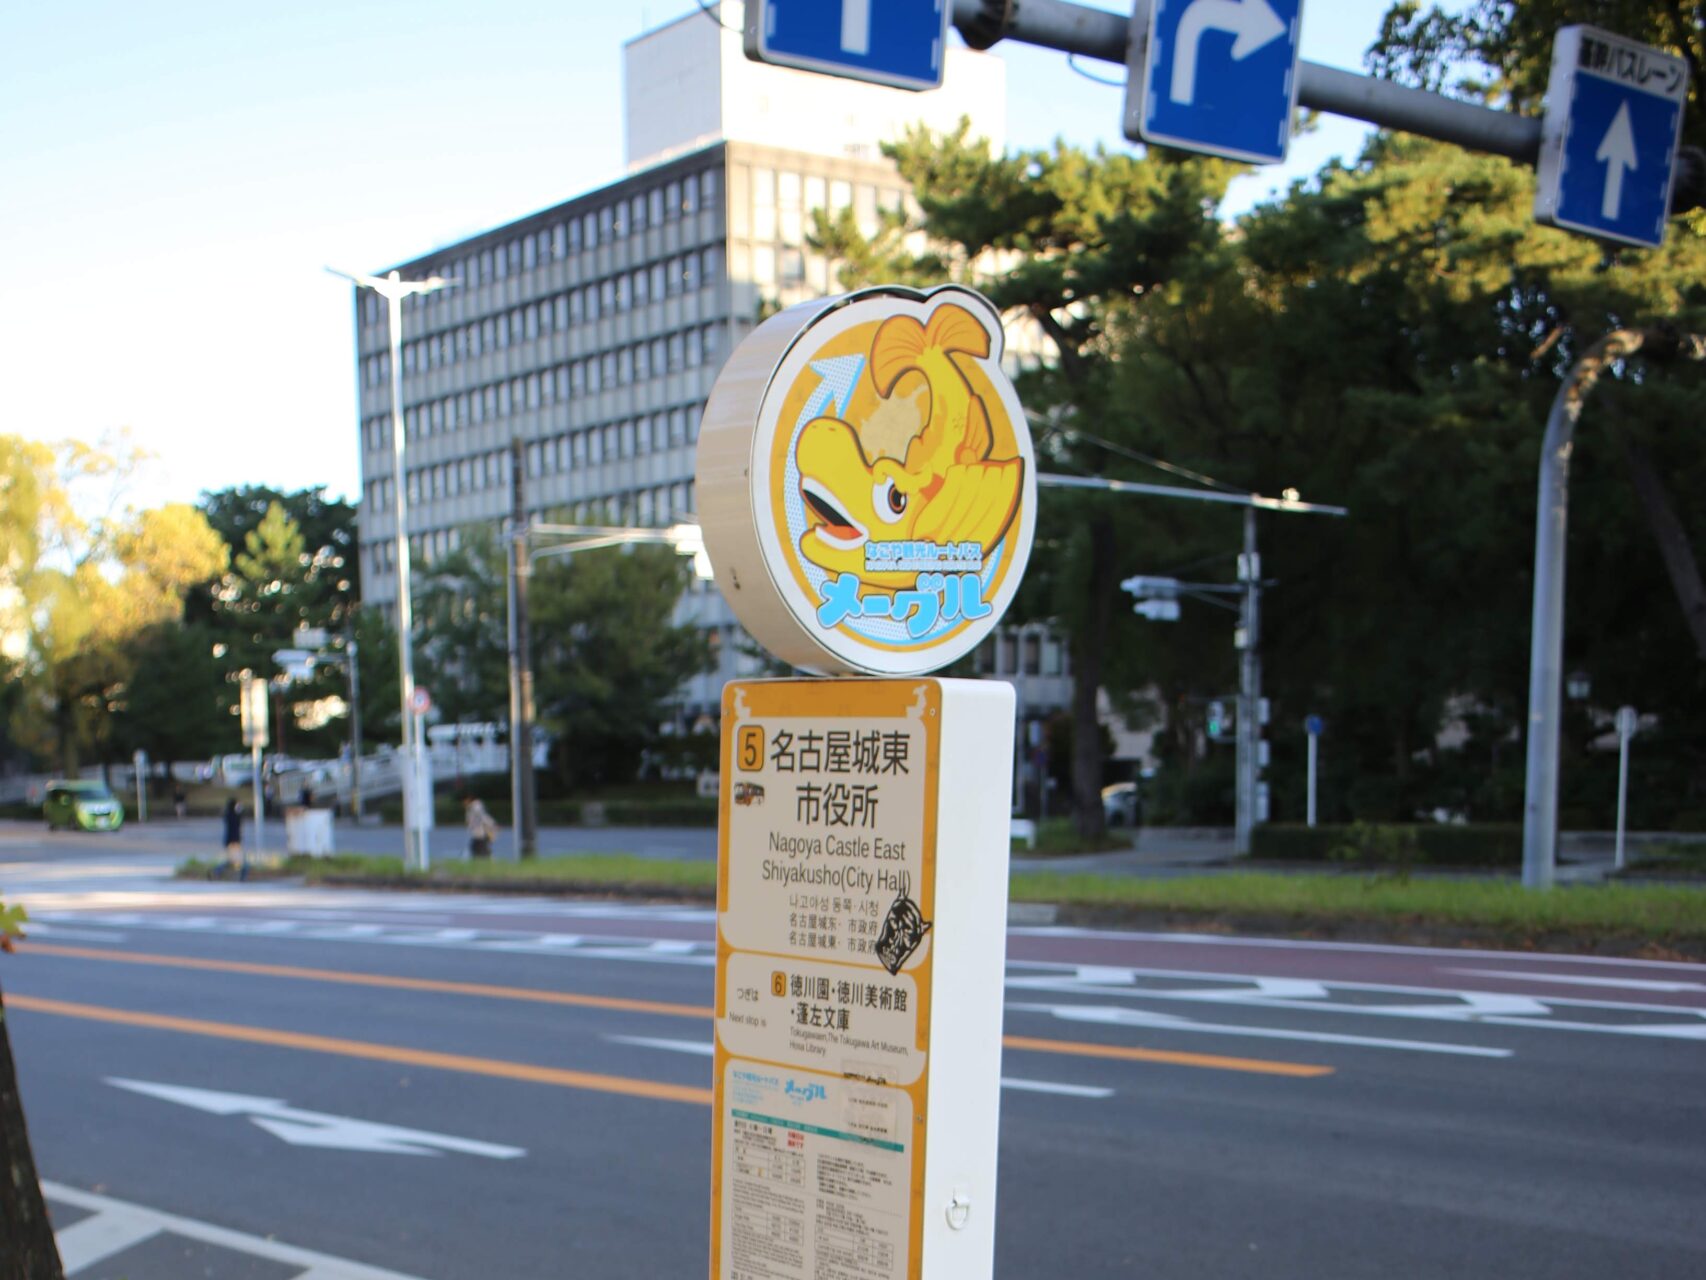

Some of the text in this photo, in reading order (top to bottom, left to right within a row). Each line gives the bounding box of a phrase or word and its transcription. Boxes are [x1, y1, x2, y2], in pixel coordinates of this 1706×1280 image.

[1579, 37, 1682, 92] バスレーン
[865, 541, 982, 558] なごや観光ルートバス
[817, 573, 992, 637] メーグル
[745, 733, 757, 766] 5
[770, 729, 910, 775] 名古屋城東
[796, 783, 879, 829] 市役所
[769, 832, 906, 861] Nagoya Castle East
[762, 859, 911, 897] Shiyakusho(City Hall)
[737, 986, 759, 1002] つぎは
[774, 974, 782, 994] 6
[729, 1011, 744, 1023] Next
[746, 1013, 759, 1026] stop
[805, 1042, 826, 1057] Library
